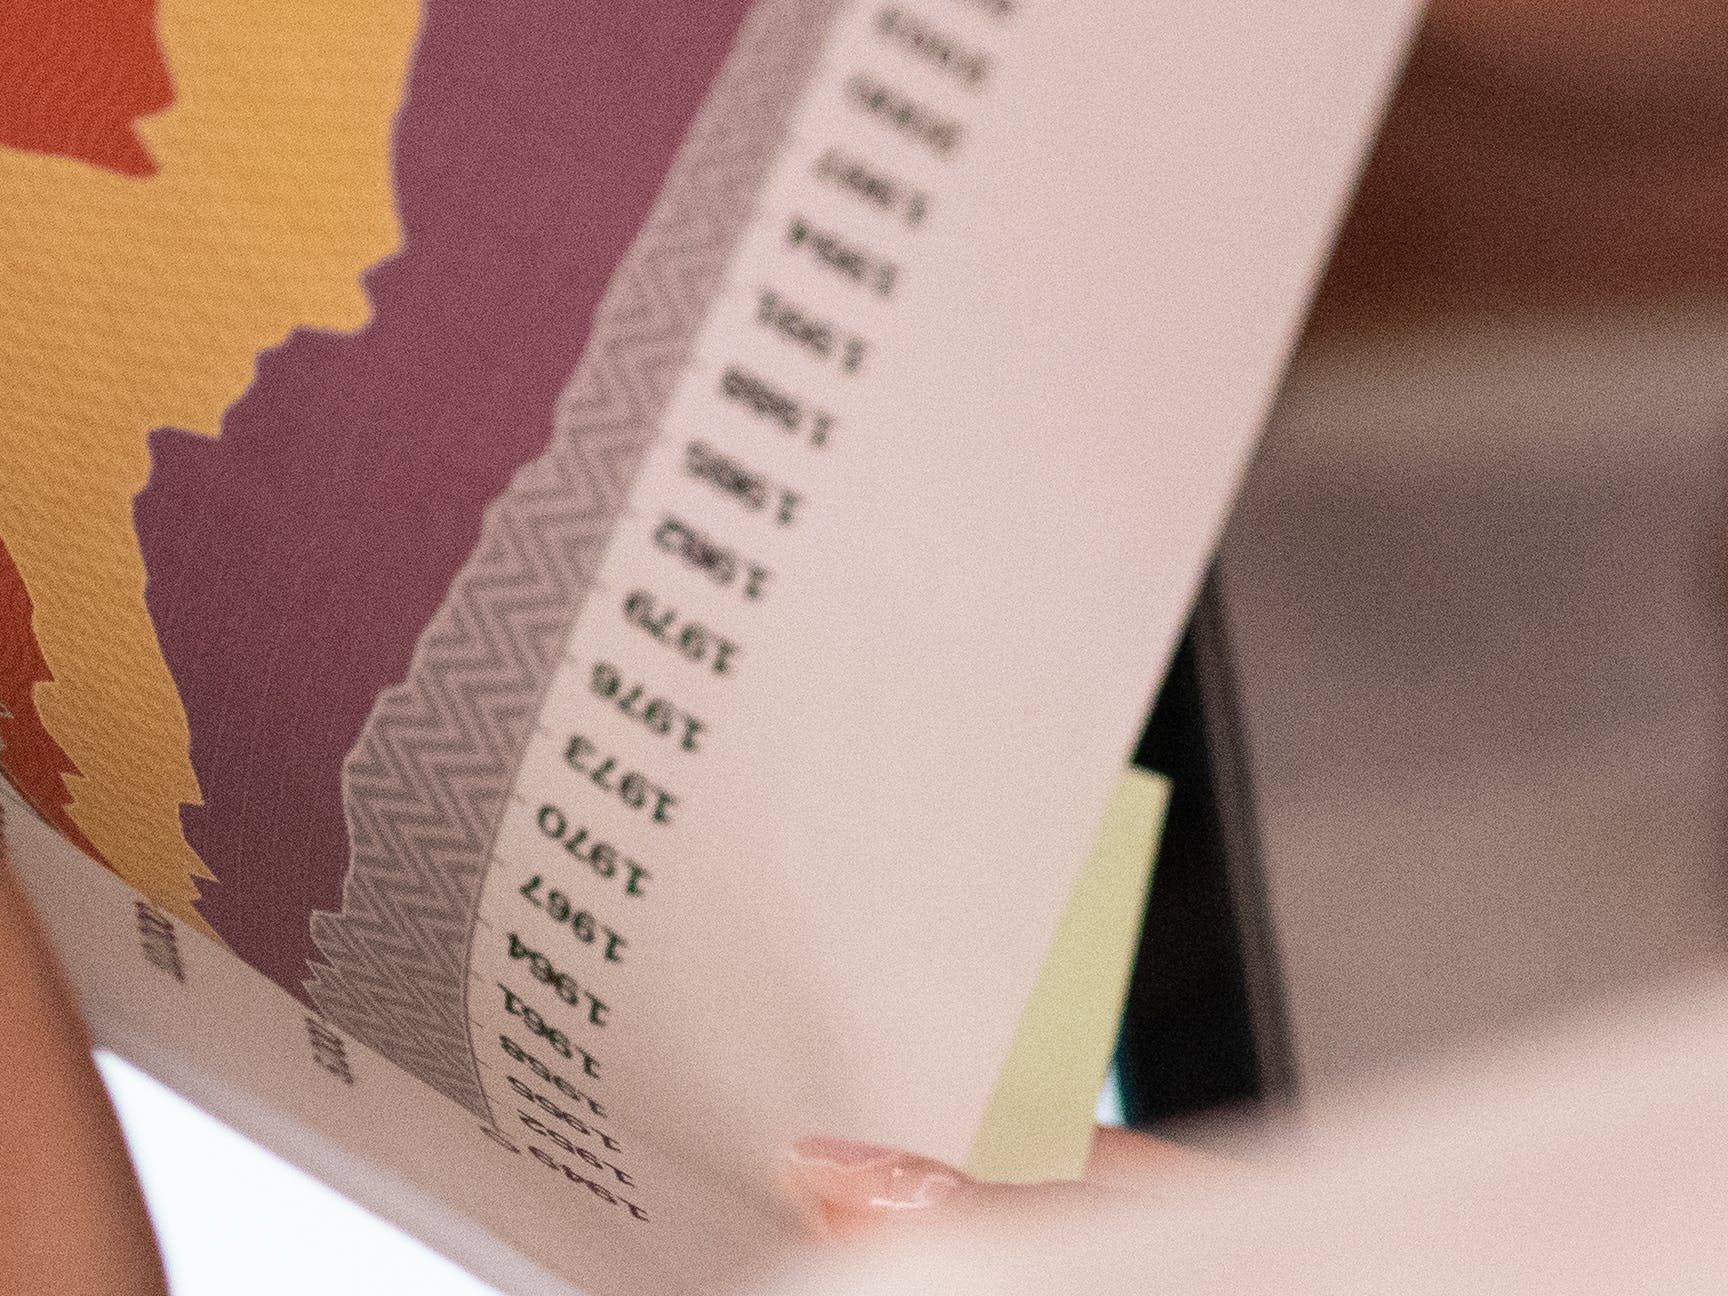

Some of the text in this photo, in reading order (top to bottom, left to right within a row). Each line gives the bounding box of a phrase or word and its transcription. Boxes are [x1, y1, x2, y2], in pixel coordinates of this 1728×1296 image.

[649, 512, 774, 604] 1982
[620, 587, 742, 679] 1979
[590, 659, 710, 756] 1976
[560, 732, 682, 829] 1973
[536, 803, 652, 899] 1970
[517, 873, 630, 965] 1967
[505, 932, 612, 1028] 1964
[496, 980, 602, 1081] 1961
[498, 1033, 609, 1120] 1958
[506, 1074, 622, 1154] 1955
[517, 1108, 637, 1189] 1952
[528, 1144, 652, 1224] 1949
